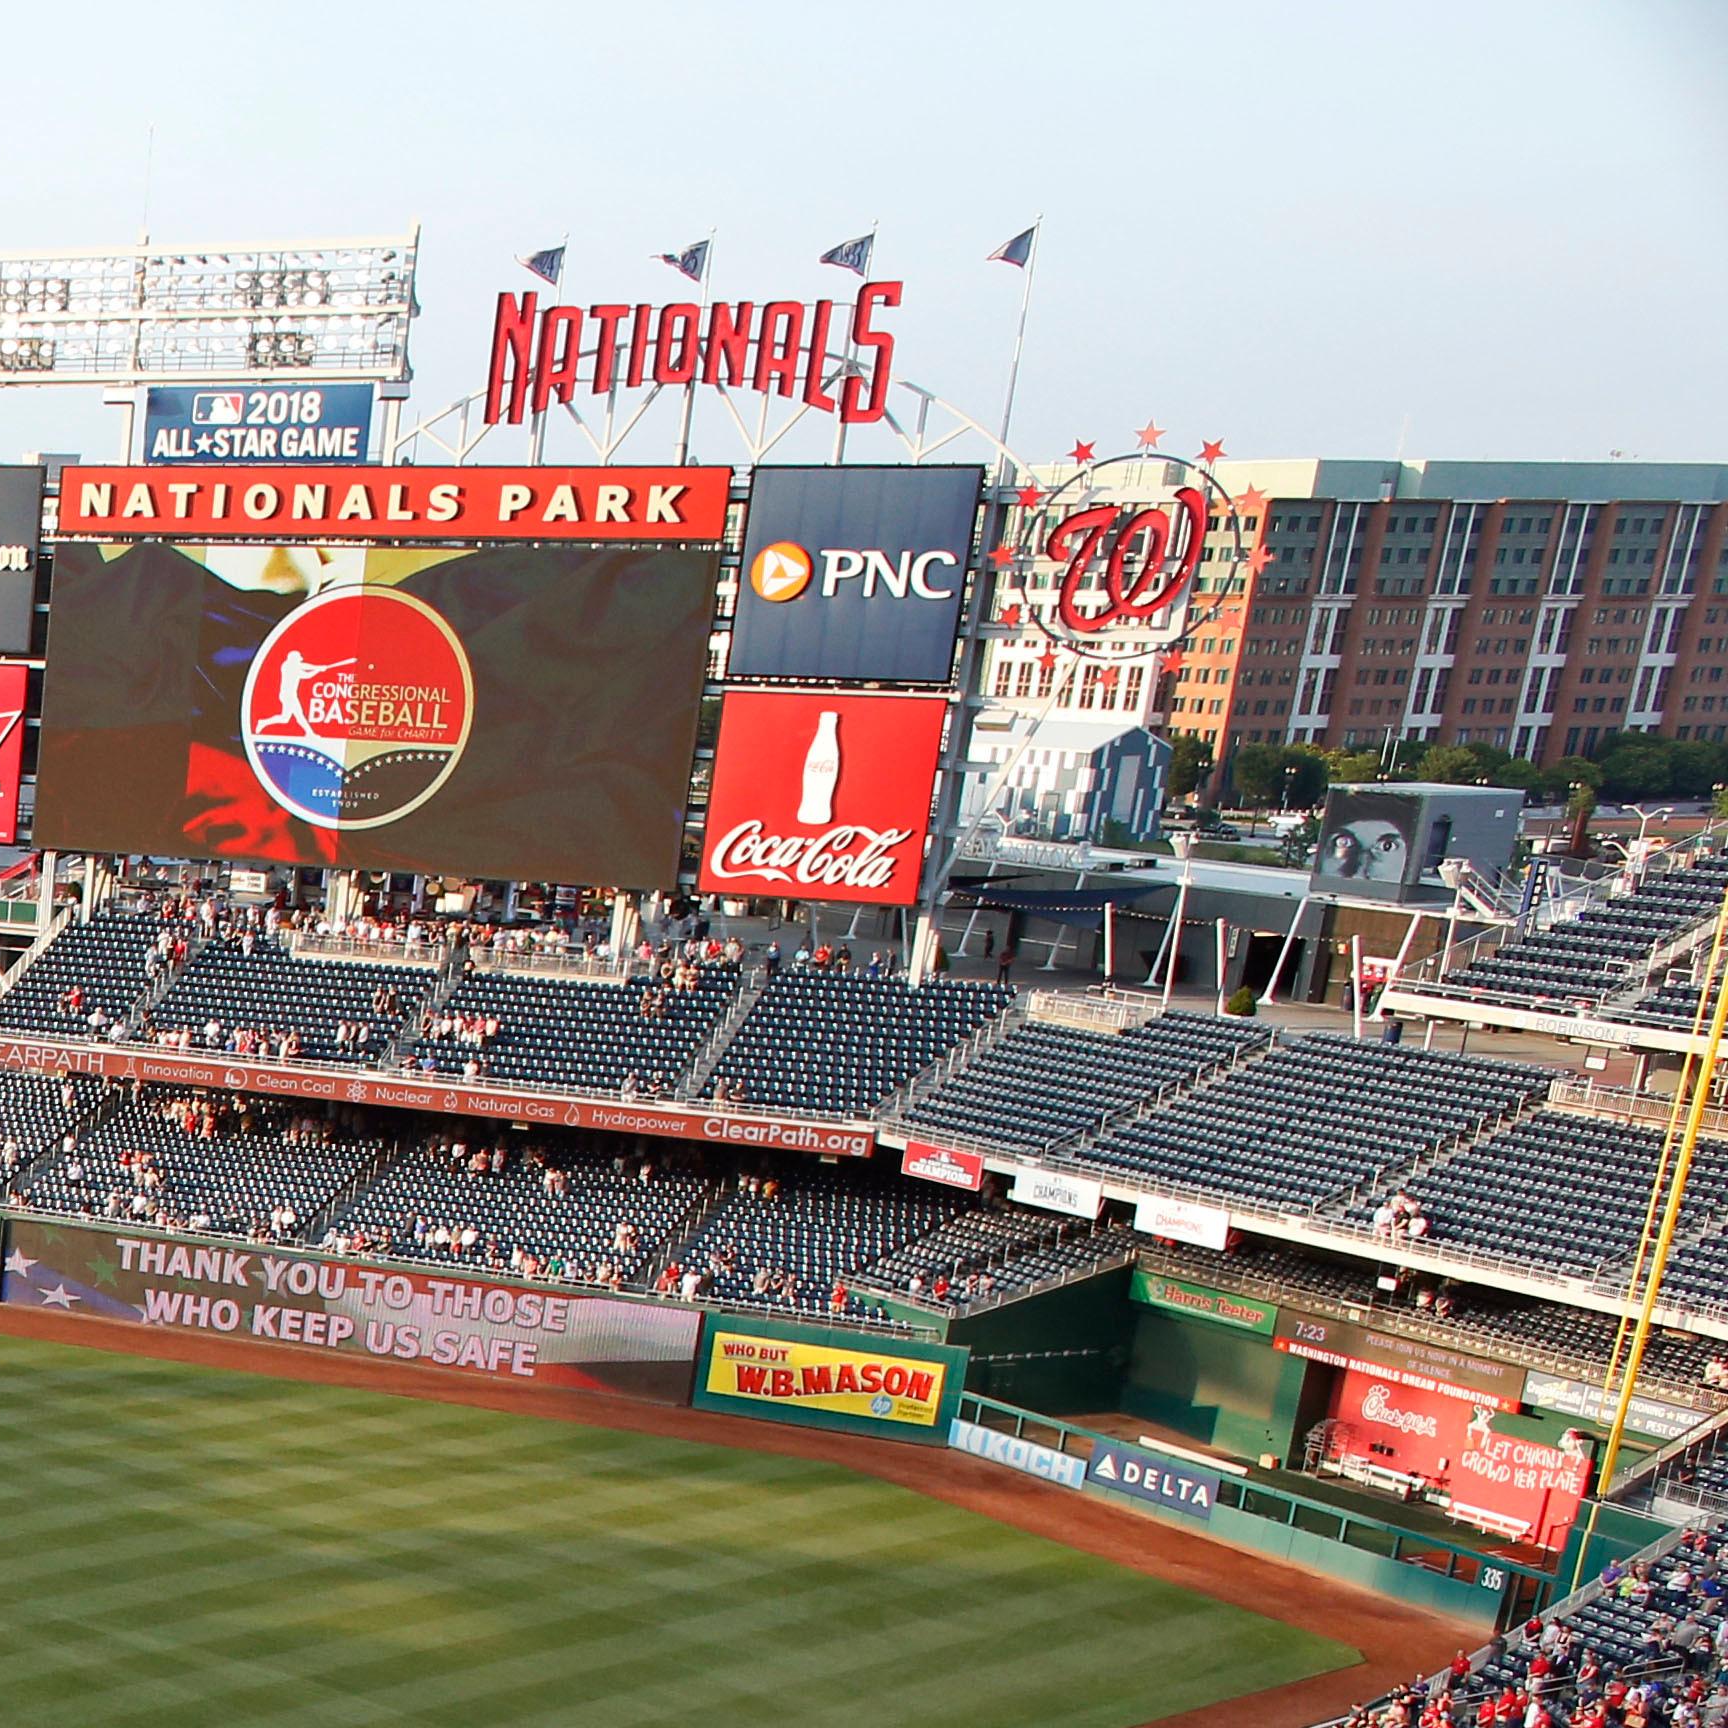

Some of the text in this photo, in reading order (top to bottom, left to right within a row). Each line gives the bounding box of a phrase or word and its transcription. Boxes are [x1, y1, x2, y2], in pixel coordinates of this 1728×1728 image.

[484, 280, 903, 425] NATIONALS
[246, 391, 321, 424] 2018
[152, 428, 360, 458] ALL STAR GAME
[79, 482, 688, 523] NATIONALS PARK
[820, 548, 959, 600] PNC
[312, 682, 451, 703] CONGRESSIONAL
[309, 699, 448, 729] BASEBALL
[349, 727, 443, 740] GAME CHARITY
[311, 789, 380, 800] ESTABLISHED
[710, 819, 912, 888] Coca-Cola
[1536, 1019, 1640, 1044] ROBINSON 42
[143, 1061, 214, 1082] Innovation
[255, 1074, 336, 1095] Clean Coal
[375, 1086, 433, 1105] Nuclear
[467, 1097, 555, 1119] Natural Gas
[591, 1108, 688, 1132] Hydropower
[702, 1118, 868, 1156] ClearPath.org
[909, 1160, 974, 1187] CHAMPIONS
[1033, 1183, 1078, 1208] CHAMPIONS
[116, 1238, 569, 1333] THANK YOU TO THOSE
[1164, 1284, 1211, 1310] Harris
[1214, 1297, 1265, 1324] Teeter
[145, 1288, 538, 1376] WHO KEEP US SAFE
[1295, 1321, 1326, 1343] 7:23
[723, 1343, 789, 1362] WHO BUT
[1365, 1334, 1505, 1378] PLEASE MOMENT
[1288, 1342, 1499, 1407] WASHINGTON NATIONALS DREAM FOUNDATION
[1418, 1362, 1451, 1380] SILENCE
[1484, 1440, 1508, 1462] LET
[1123, 1462, 1209, 1508] DELTA
[1462, 1452, 1580, 1495] CROWD YER PLATE
[1481, 1567, 1503, 1590] 335
